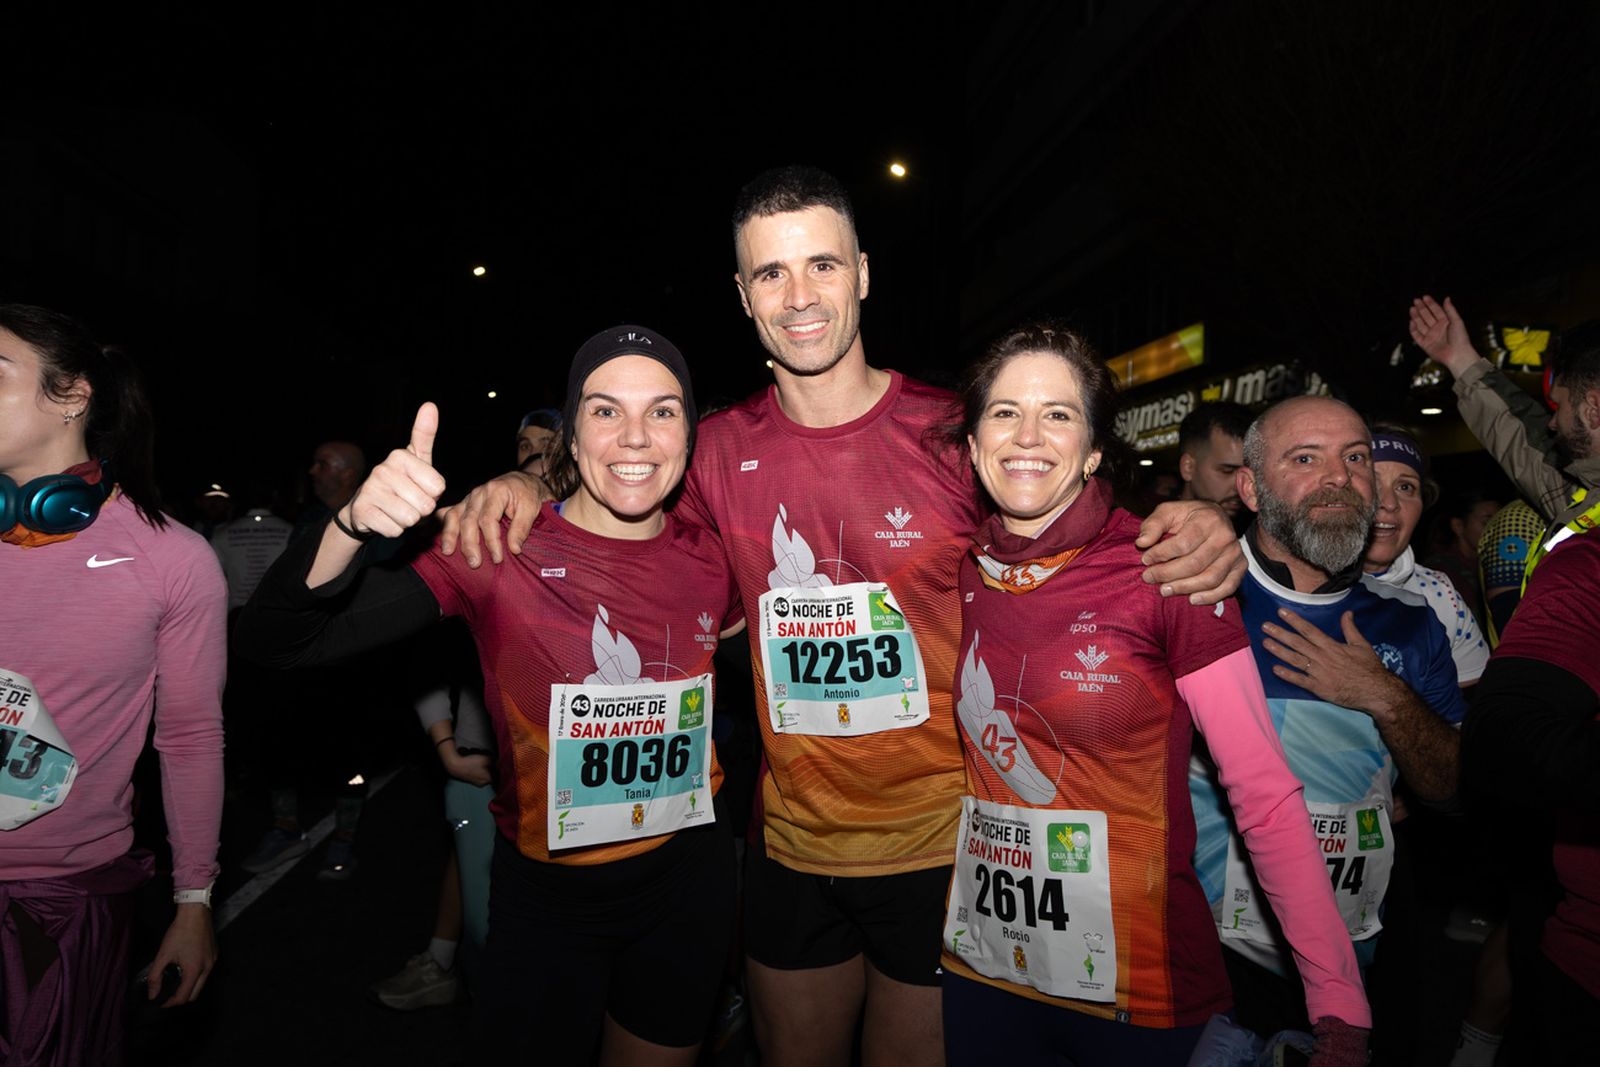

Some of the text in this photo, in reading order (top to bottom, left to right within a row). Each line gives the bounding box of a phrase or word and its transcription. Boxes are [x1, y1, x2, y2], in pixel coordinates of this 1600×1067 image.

[792, 602, 854, 618] NOCHE DE
[778, 617, 856, 638] SAN ANTÓN
[782, 634, 902, 685] 12253
[1087, 672, 1121, 684] RURAL
[6, 690, 31, 707] DE
[824, 688, 860, 700] Antonio
[572, 699, 590, 712] 43
[593, 700, 667, 718] NOCHE DE
[570, 715, 666, 738] SAN ANTÓN
[981, 723, 1017, 773] 43
[580, 734, 691, 788] 8036
[624, 787, 651, 800] Tania
[981, 820, 1012, 843] NOCHE
[1015, 827, 1031, 846] DE
[1329, 819, 1347, 834] DE
[968, 837, 1032, 870] SAN ANTÓN
[1326, 856, 1366, 896] 74
[975, 863, 1070, 931] 2614
[1002, 926, 1030, 943] Rocio
